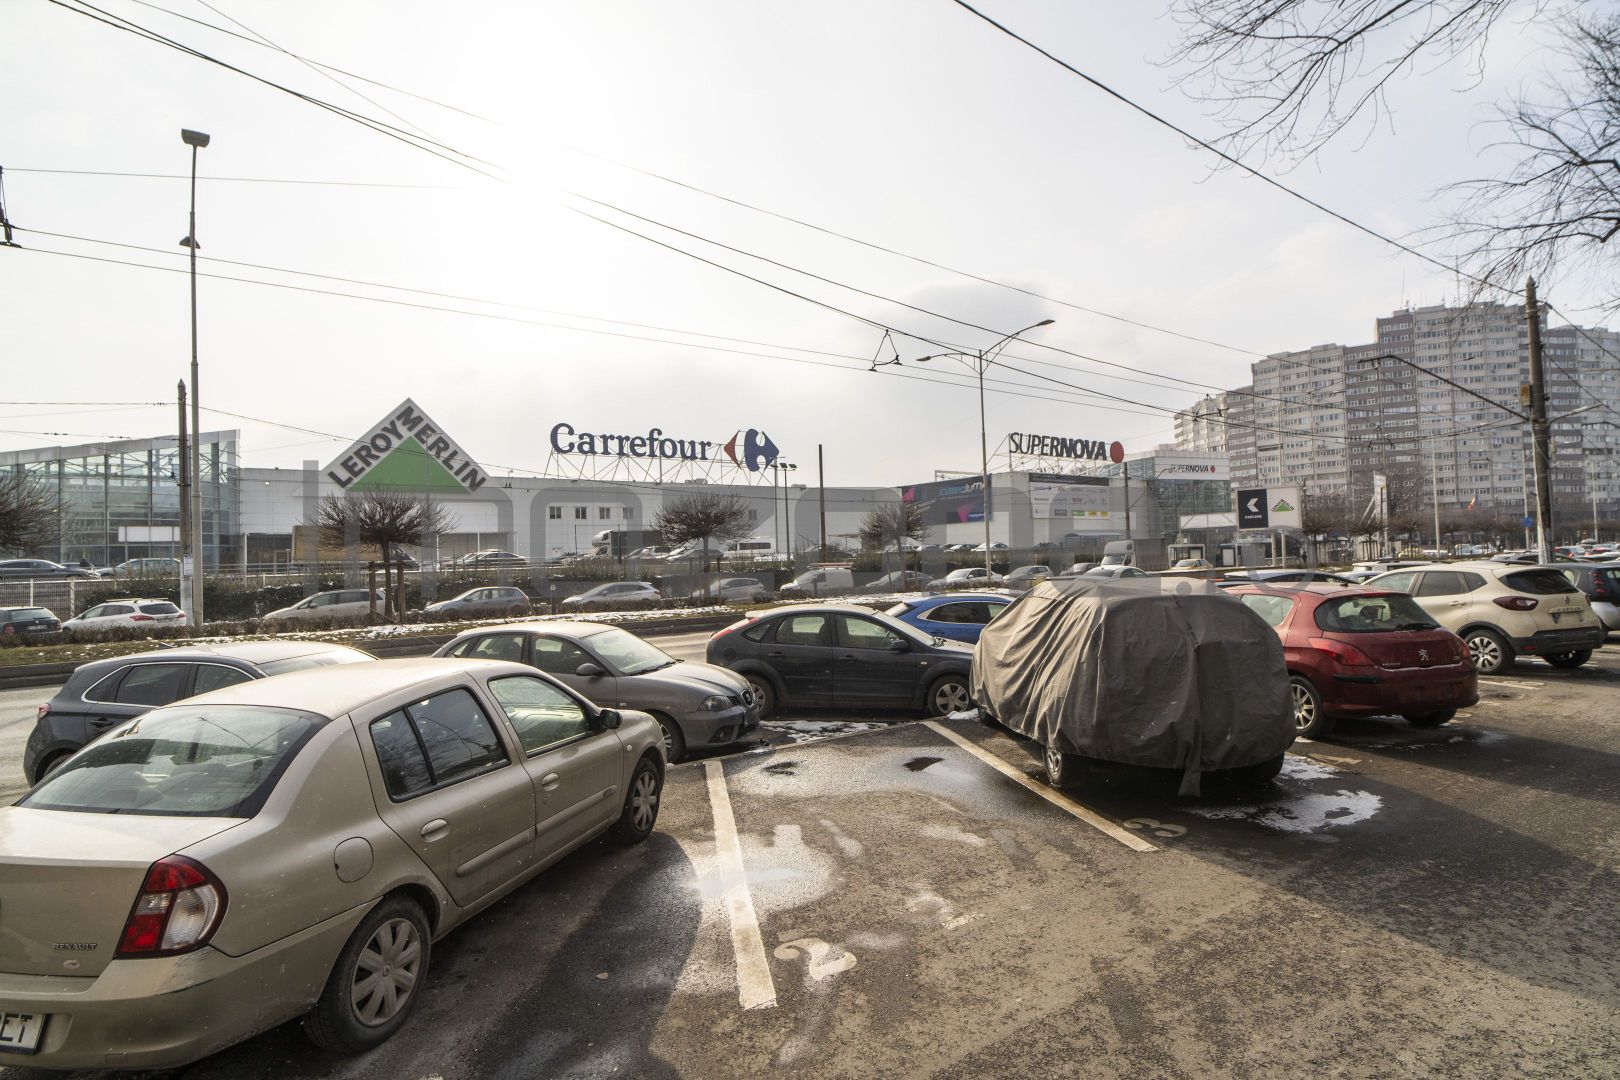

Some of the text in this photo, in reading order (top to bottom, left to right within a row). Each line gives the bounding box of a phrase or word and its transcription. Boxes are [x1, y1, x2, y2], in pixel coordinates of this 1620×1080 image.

[328, 406, 487, 491] LEROY MERLIN
[550, 422, 712, 461] Carrefour
[1010, 432, 1107, 461] SUPERNOVA
[53, 943, 97, 951] RENAULT
[773, 937, 857, 980] 2
